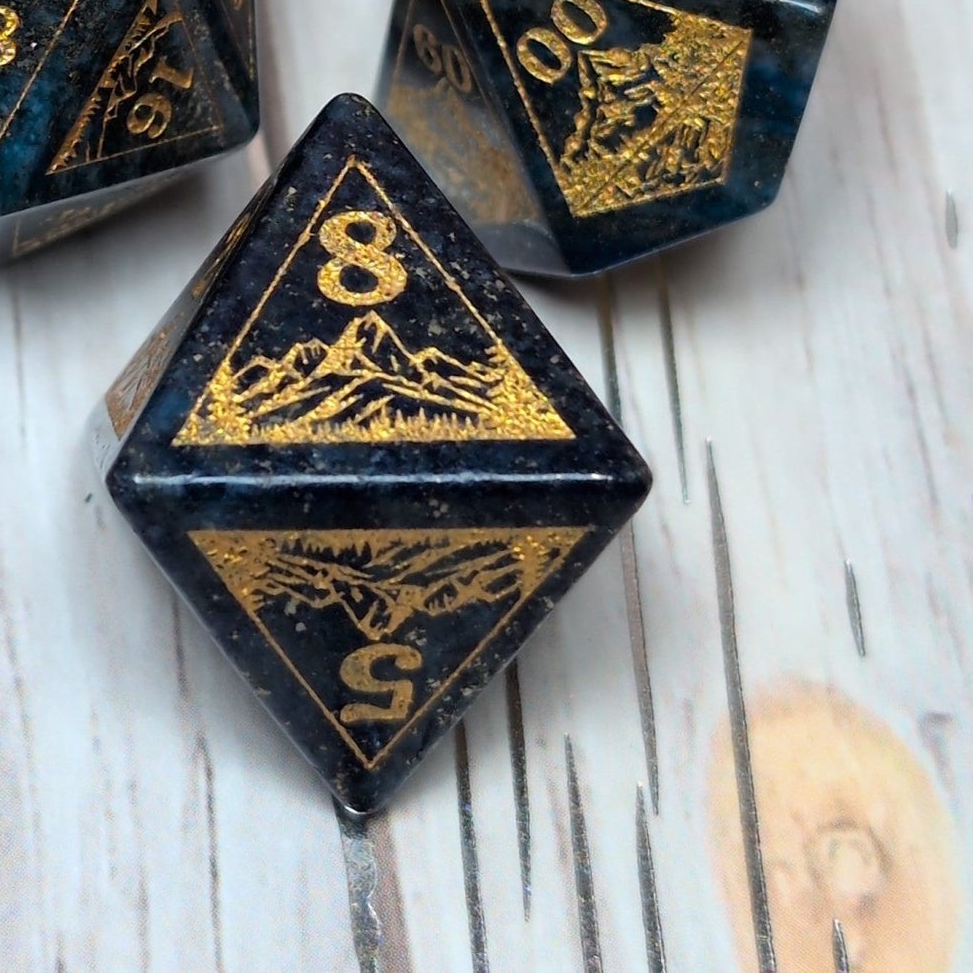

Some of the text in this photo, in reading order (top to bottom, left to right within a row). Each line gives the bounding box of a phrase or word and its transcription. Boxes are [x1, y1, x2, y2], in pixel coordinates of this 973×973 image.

[126, 61, 195, 140] 16
[316, 210, 408, 306] 8
[338, 642, 424, 723] 5
